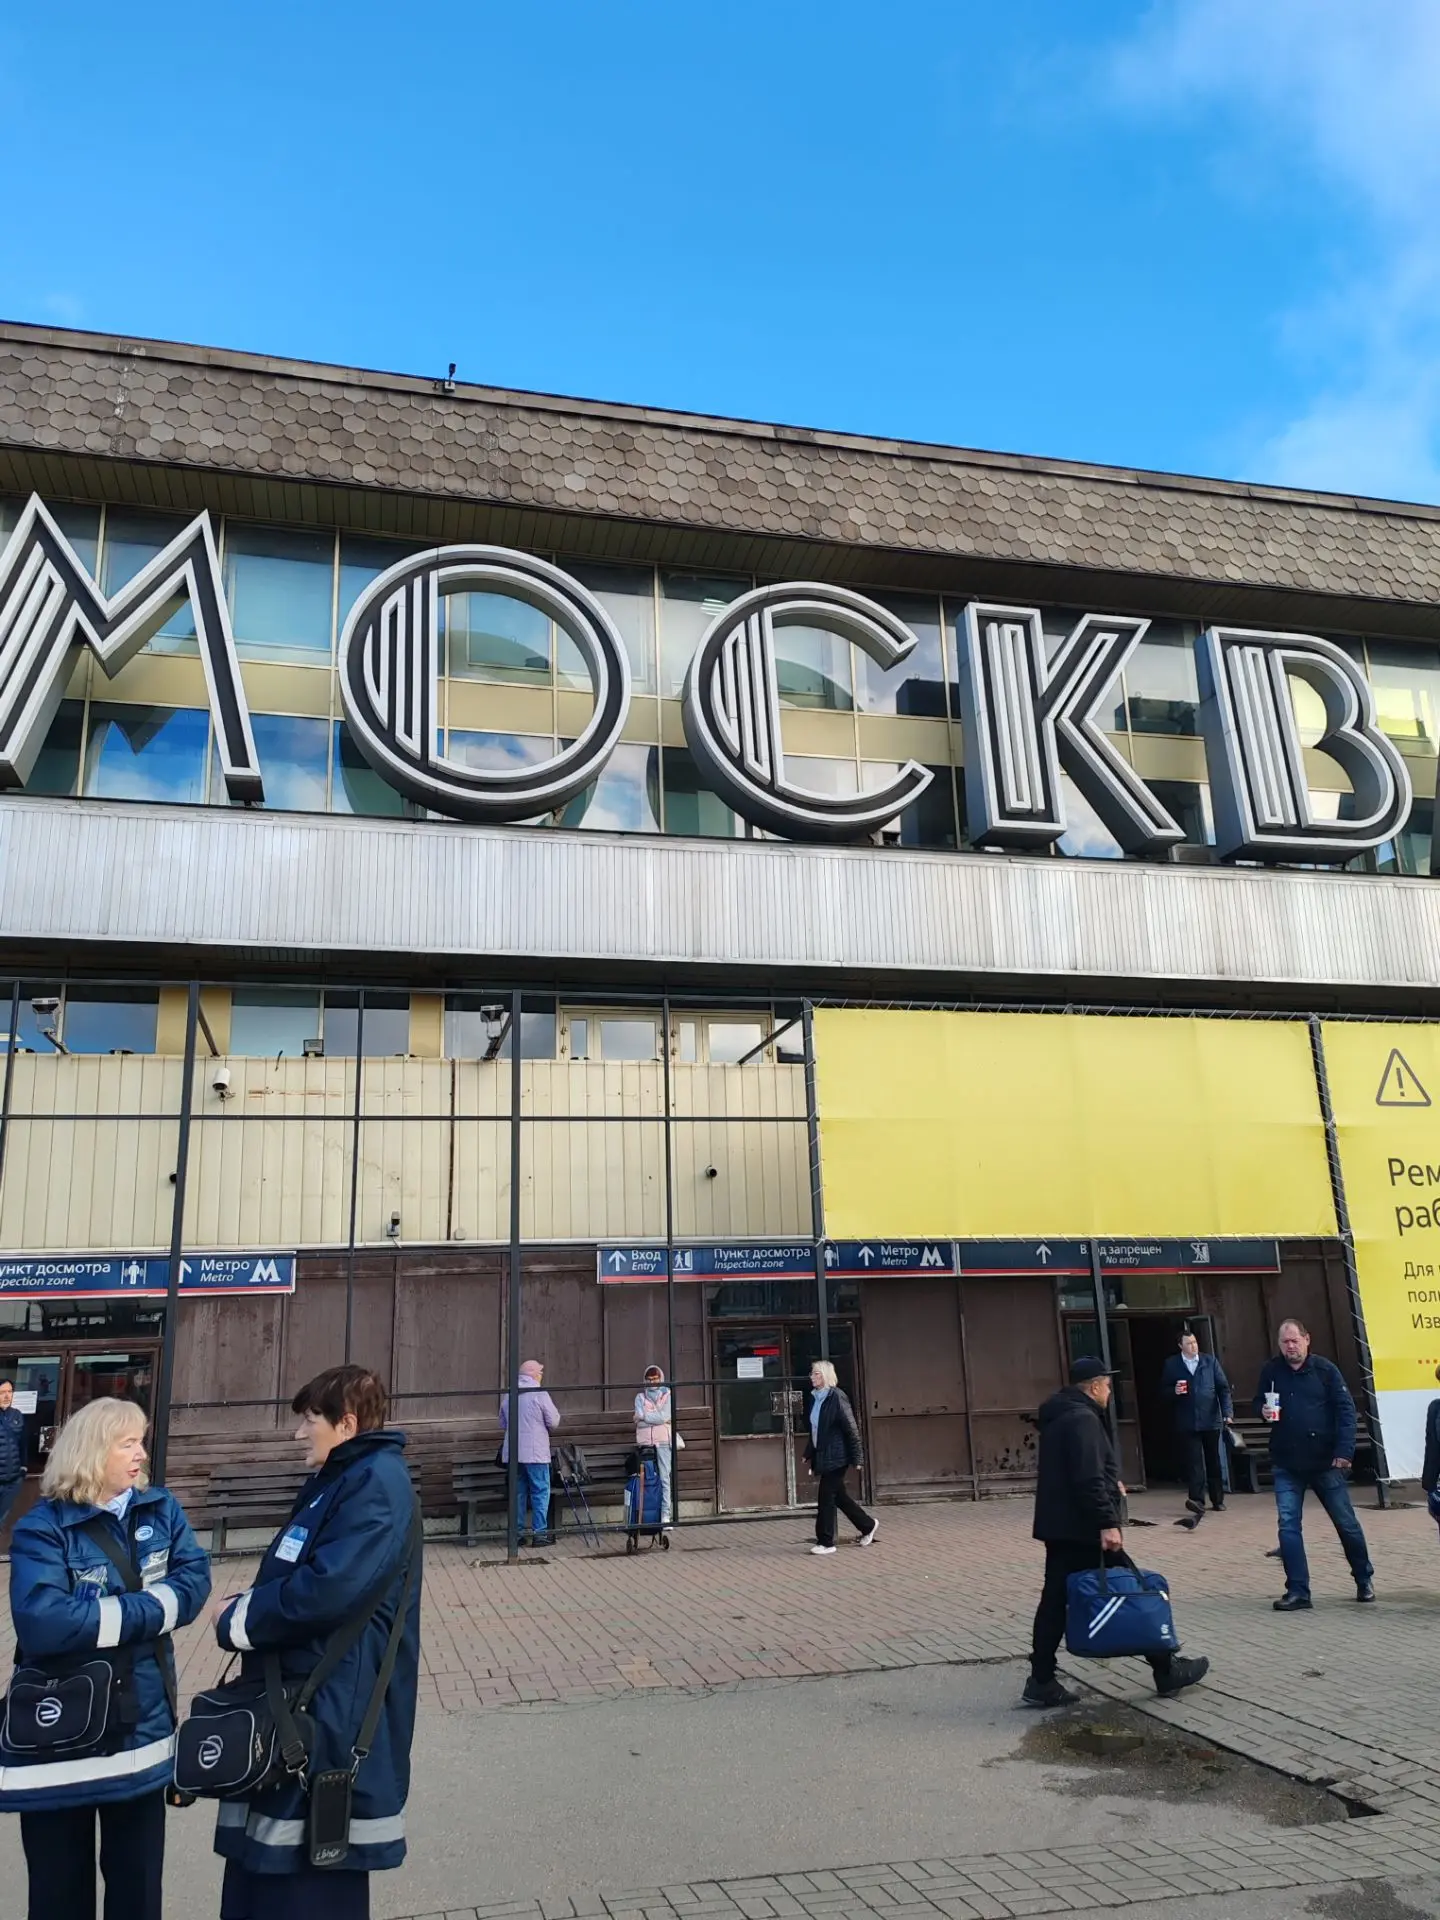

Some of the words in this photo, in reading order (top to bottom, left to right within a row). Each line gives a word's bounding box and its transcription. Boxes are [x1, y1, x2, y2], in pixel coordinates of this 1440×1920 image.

[631, 1250, 661, 1262] Вход
[714, 1248, 749, 1260] Пункт
[752, 1247, 811, 1260] досмотра
[880, 1245, 919, 1259] Метро
[1109, 1244, 1162, 1256] запрещен
[714, 1259, 760, 1270] Inspection
[761, 1260, 784, 1268] zone
[882, 1257, 908, 1266] Metro
[1106, 1256, 1117, 1264] No
[1119, 1255, 1140, 1265] entry
[36, 1263, 111, 1277] досмотра
[201, 1259, 250, 1274] Метро
[632, 1262, 656, 1272] Entry
[1404, 1261, 1434, 1280] Для
[46, 1277, 75, 1286] zone
[200, 1273, 234, 1282] Metro
[1407, 1290, 1440, 1303] пол
